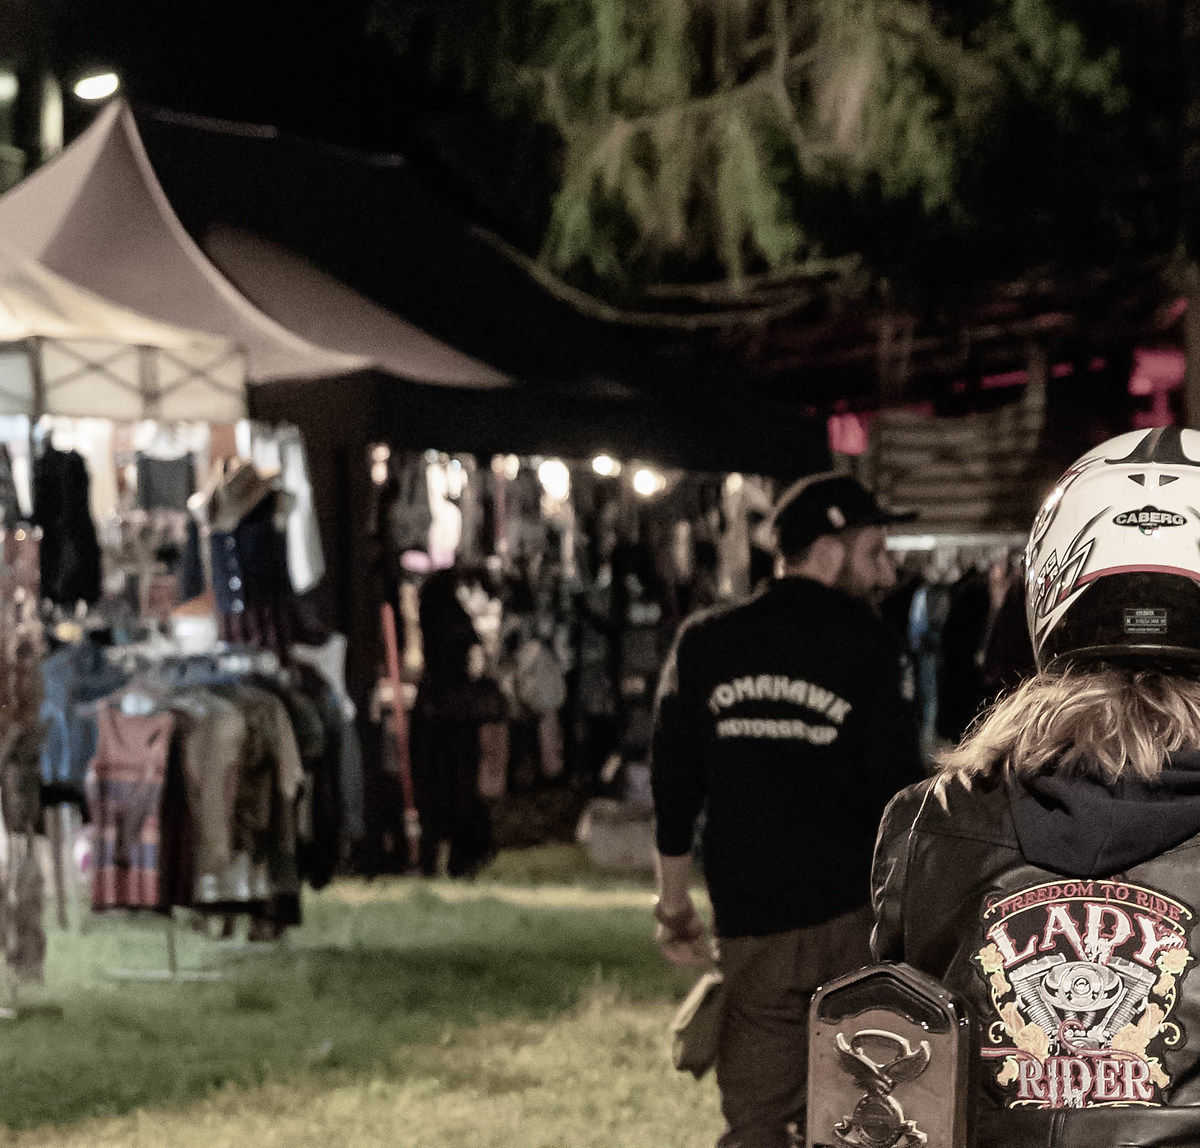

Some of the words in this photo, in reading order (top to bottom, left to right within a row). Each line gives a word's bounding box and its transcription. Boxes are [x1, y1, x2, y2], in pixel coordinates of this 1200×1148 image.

[1116, 512, 1184, 525] CABERG
[1000, 882, 1094, 918] FREEDOM
[1101, 884, 1130, 904] TO
[1136, 890, 1182, 922] RIDE
[987, 902, 1187, 969] LADY
[1017, 1056, 1154, 1108] RIDER
